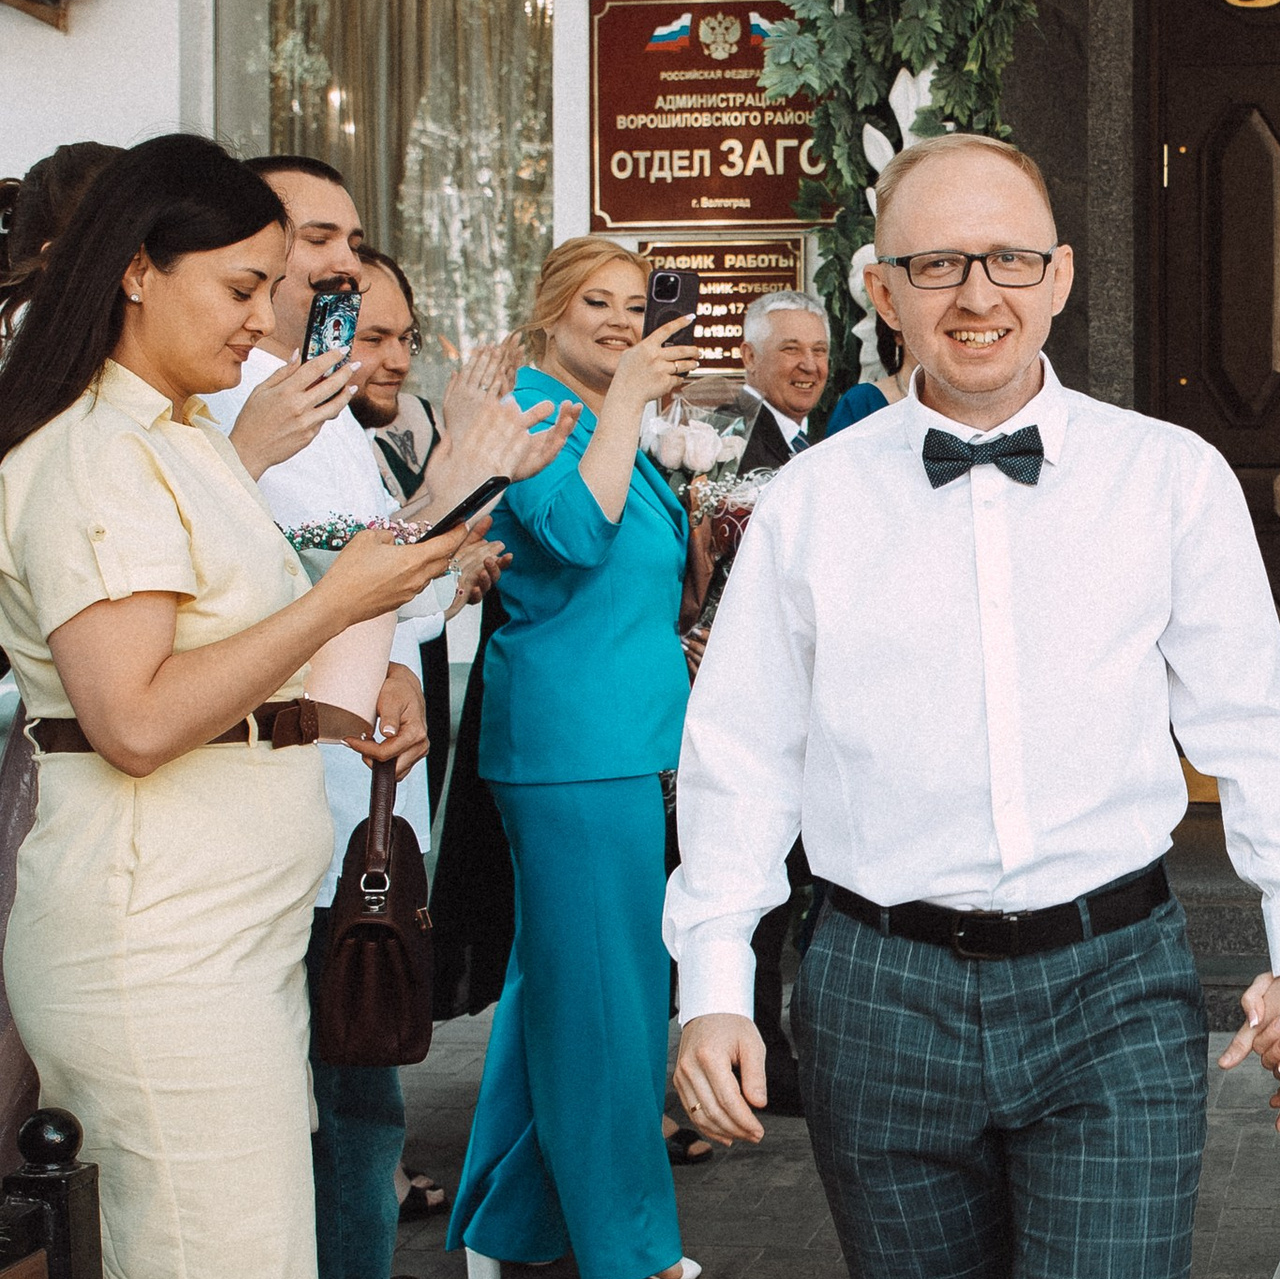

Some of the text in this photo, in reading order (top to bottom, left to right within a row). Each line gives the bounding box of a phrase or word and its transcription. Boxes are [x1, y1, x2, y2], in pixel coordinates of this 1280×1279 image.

[660, 69, 763, 80] РОССИЙСКАЯ ФЕДЕРА
[616, 109, 816, 129] ВОРОШИЛОВСКОГО РАЙОН
[610, 138, 827, 184] ОТДЕЛ ЗАГС
[725, 254, 794, 268] РАБОТЫ
[699, 282, 792, 294] ЬНИК-СУББОТА
